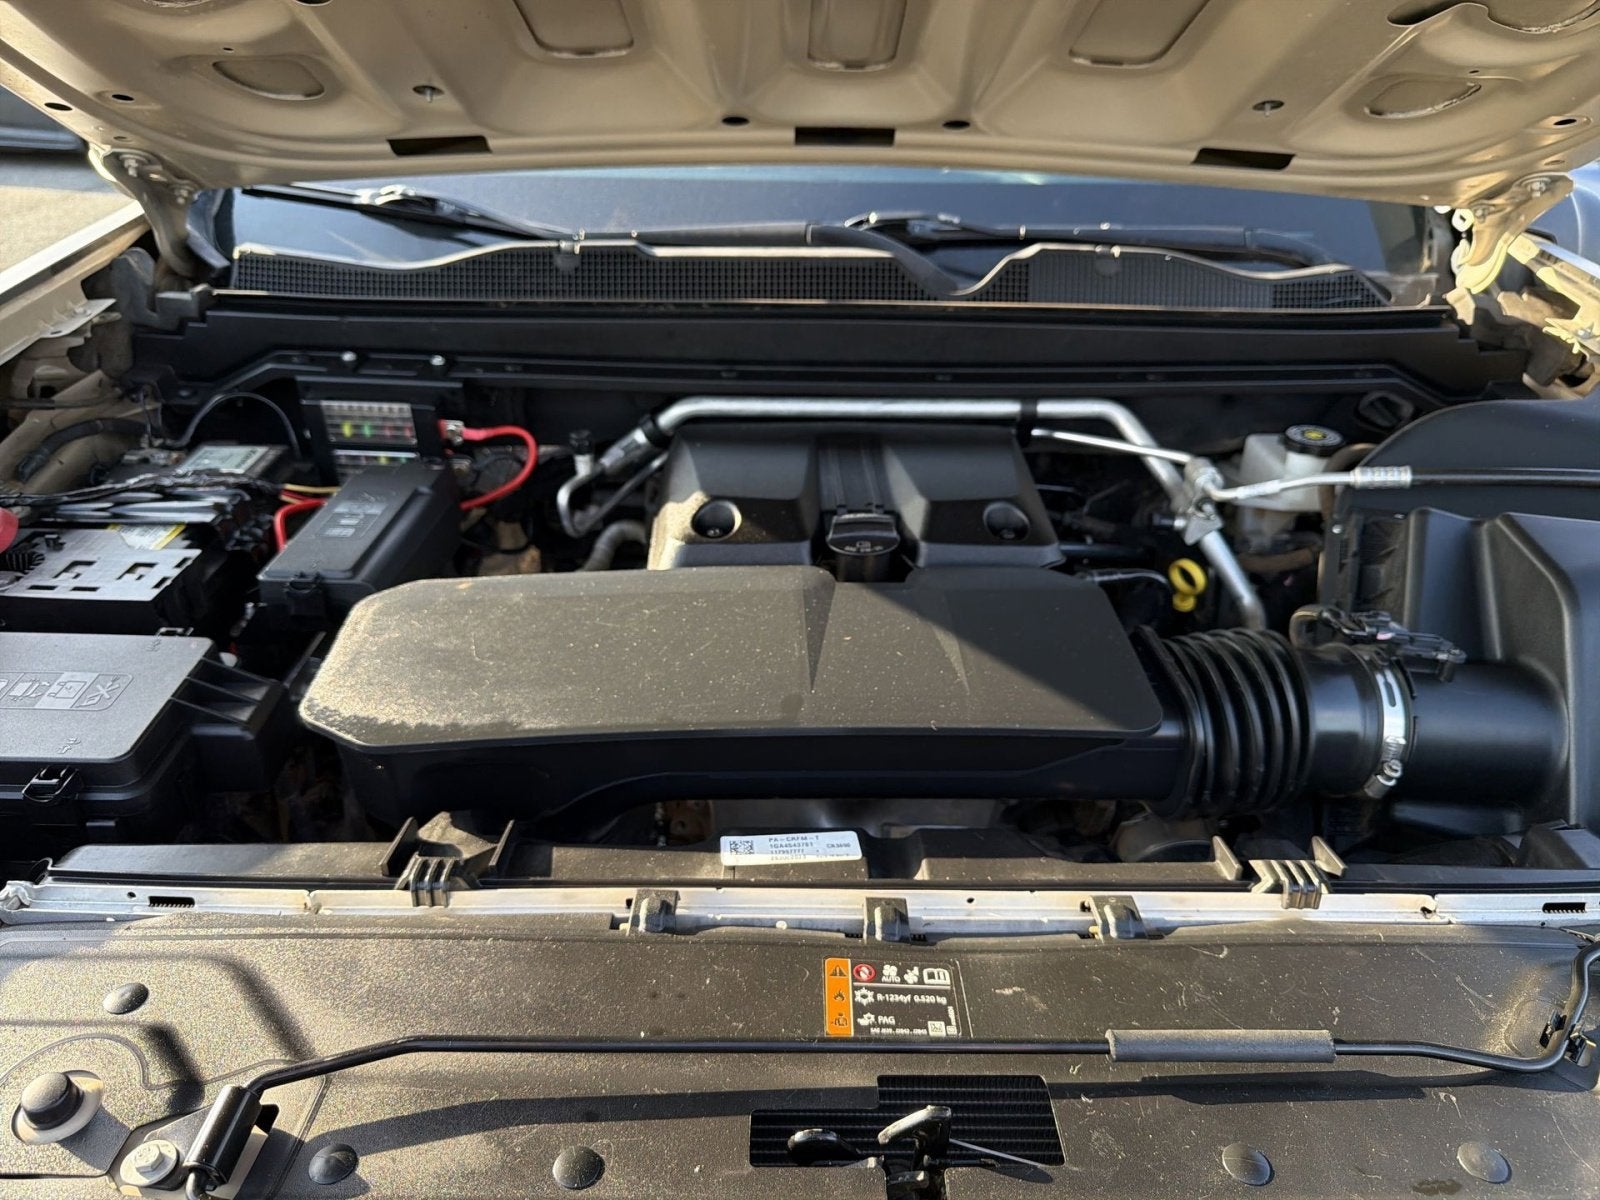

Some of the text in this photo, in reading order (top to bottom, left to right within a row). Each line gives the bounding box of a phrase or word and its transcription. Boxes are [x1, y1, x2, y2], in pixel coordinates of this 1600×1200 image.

[881, 975, 901, 984] AUTO
[936, 995, 947, 1006] kg
[878, 1015, 896, 1025] PAG
